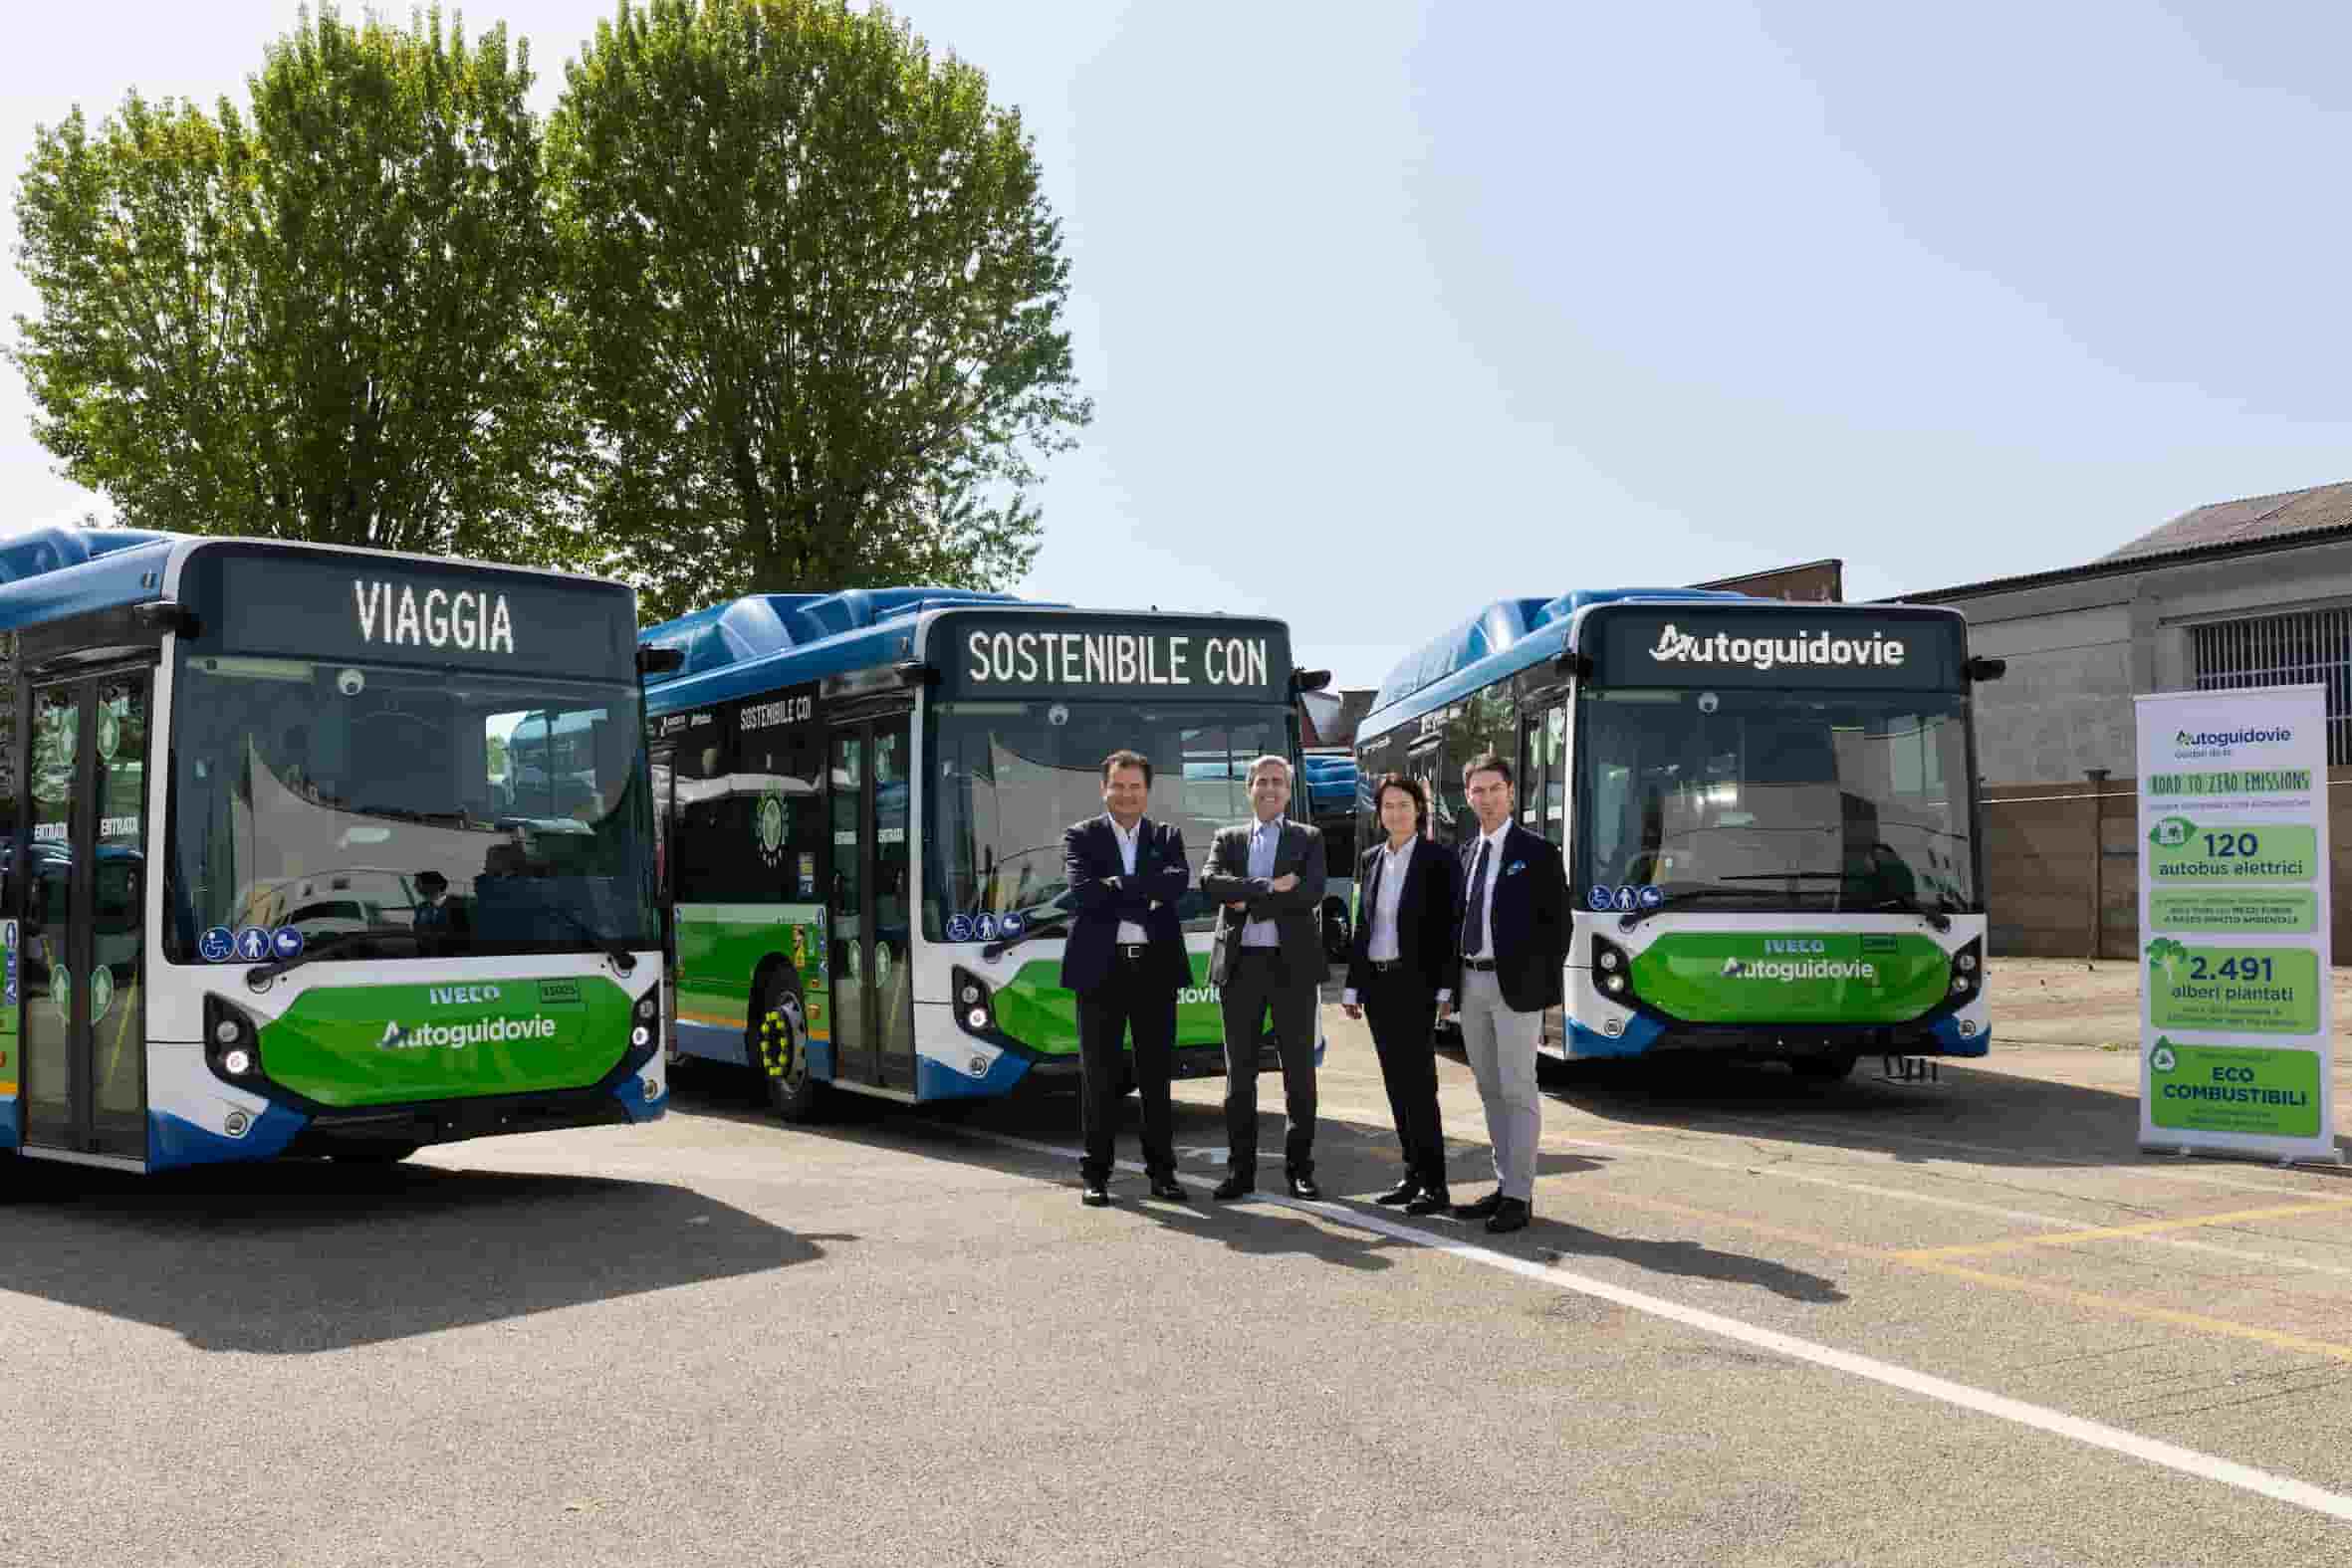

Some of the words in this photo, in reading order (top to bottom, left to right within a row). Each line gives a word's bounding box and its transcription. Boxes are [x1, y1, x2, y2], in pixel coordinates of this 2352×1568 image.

[354, 580, 513, 653] VIAGGIA
[1648, 623, 1904, 669] Autoguidovie
[969, 632, 1190, 685] SOSTENIBILE
[1205, 637, 1267, 685] CON
[741, 698, 796, 731] SOSTENIBILE
[2176, 727, 2291, 747] Autoguidovie
[2152, 774, 2182, 795] ROAD
[2189, 775, 2202, 794] TO
[2208, 773, 2238, 793] ZERO
[2245, 772, 2309, 791] EMISSIONS
[2204, 832, 2258, 858] 120
[2159, 860, 2229, 876] autobus
[2234, 859, 2302, 875] elettrici
[1764, 939, 1825, 955] IVECO
[1721, 957, 1874, 982] Autoguidovie
[2190, 957, 2273, 982] 2.491
[430, 985, 501, 1004] IVECO
[2171, 984, 2220, 1001] alberi
[2225, 986, 2294, 1004] piantati
[376, 1013, 557, 1049] Autoguidovie
[2212, 1067, 2254, 1083] ECO
[2163, 1084, 2308, 1107] COMBUSTIBILI
